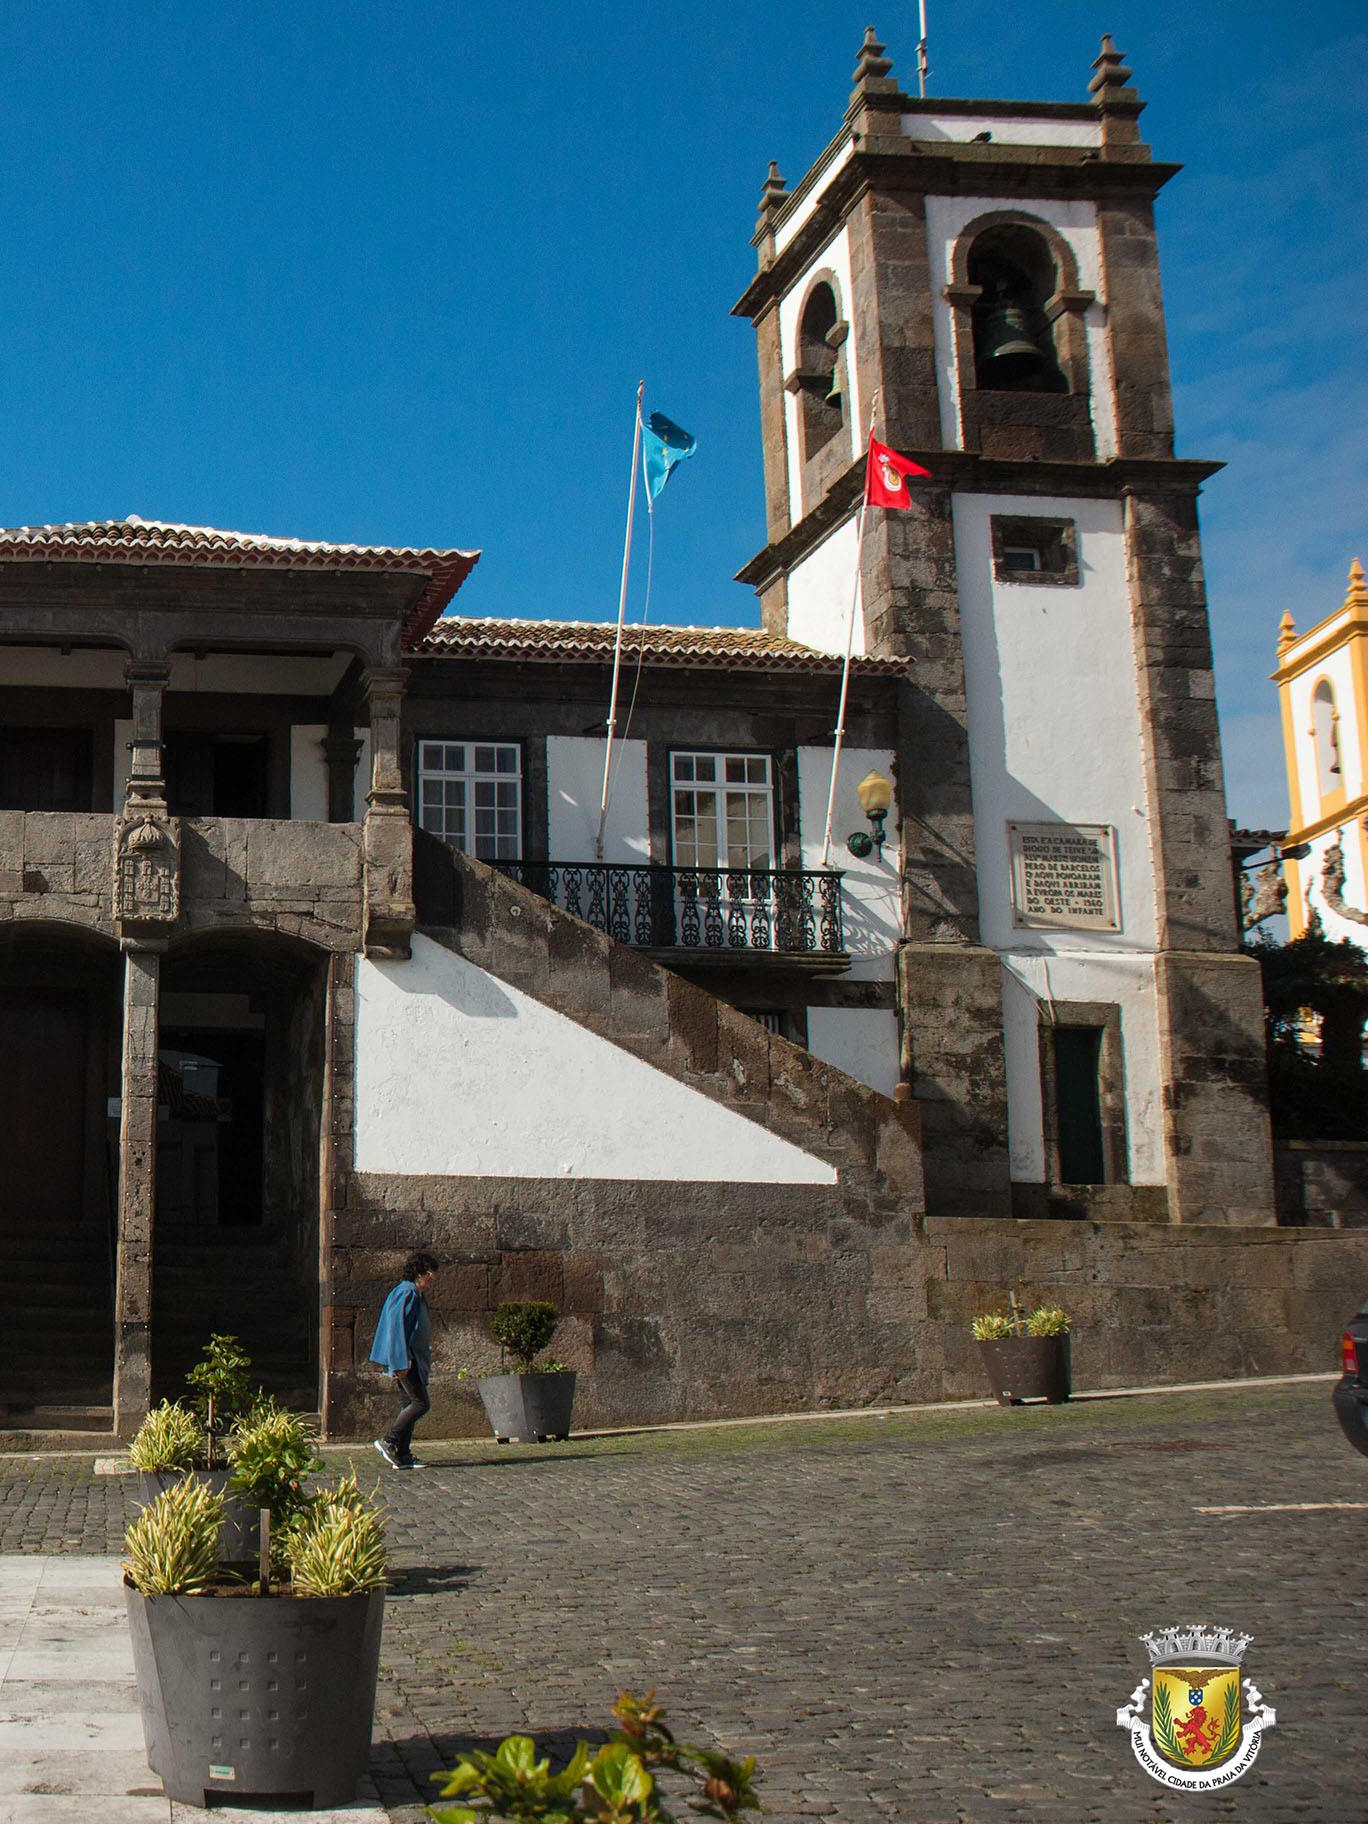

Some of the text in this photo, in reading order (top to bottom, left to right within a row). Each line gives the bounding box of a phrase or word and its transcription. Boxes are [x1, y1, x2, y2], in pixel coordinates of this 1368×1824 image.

[1022, 836, 1040, 844] ESTA
[1023, 845, 1050, 853] DIOGO
[1064, 846, 1087, 854] TEIVE
[1024, 862, 1101, 872] PERO DE BARCELOS
[1025, 879, 1031, 887] E
[1062, 881, 1102, 889] ABRIRAM
[1064, 889, 1075, 897] OS
[1076, 890, 1103, 898] MARES
[1026, 897, 1040, 905] DO
[1044, 897, 1070, 906] OESTE
[1051, 906, 1063, 914] DO
[1068, 907, 1104, 915] INFANTE
